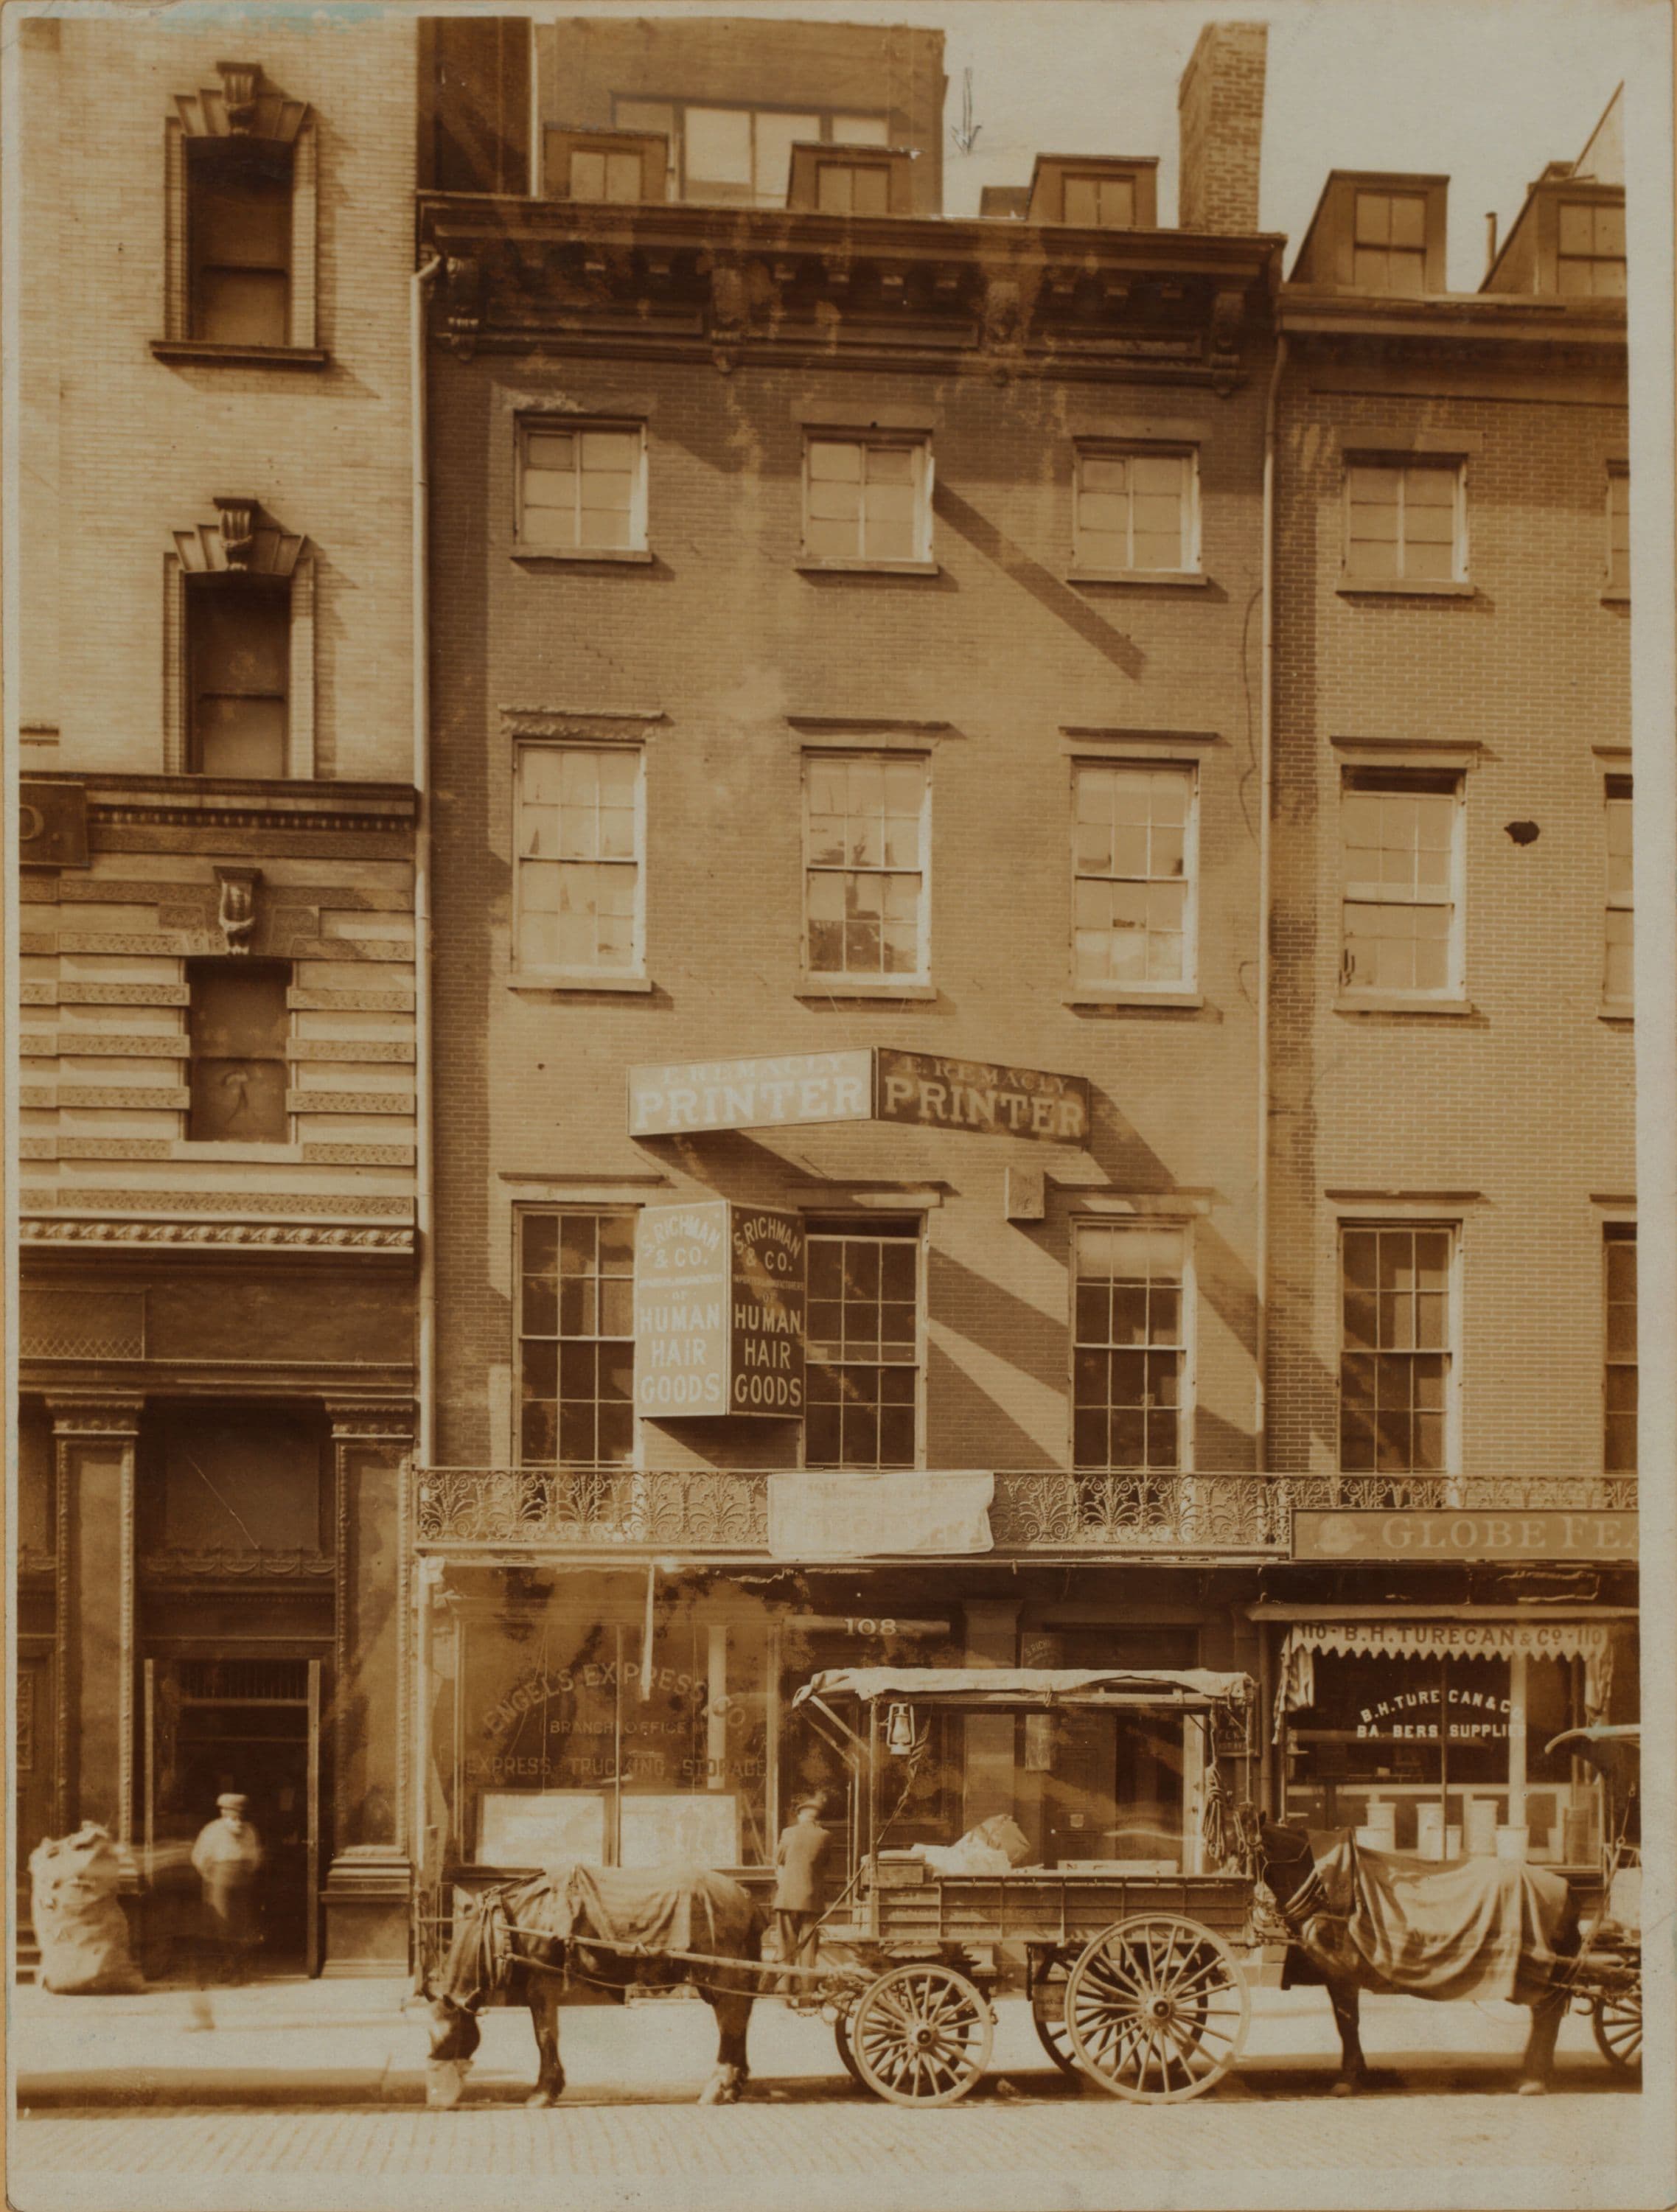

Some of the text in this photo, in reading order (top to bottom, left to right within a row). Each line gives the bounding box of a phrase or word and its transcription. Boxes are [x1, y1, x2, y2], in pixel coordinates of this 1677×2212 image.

[635, 1075, 866, 1130] PRINTER
[885, 1077, 1085, 1137] PRINTER
[743, 1217, 801, 1259] RICHMAN
[655, 1246, 708, 1268] & CO.
[746, 1248, 793, 1271] & CO.
[641, 1303, 720, 1333] HUMAN
[735, 1303, 801, 1334] HUMAN
[651, 1338, 707, 1367] HAIR
[744, 1338, 791, 1370] HAIR
[641, 1372, 720, 1403] GOODS
[735, 1373, 802, 1407] GOODS
[1382, 1515, 1546, 1549] GLOBE
[845, 1618, 896, 1636] 108
[1397, 1627, 1516, 1645] TURECAN
[1578, 1628, 1602, 1644] 110
[551, 1721, 613, 1734] BRANCH
[624, 1721, 686, 1734] OFFICE
[467, 1756, 551, 1776] EXPRESS
